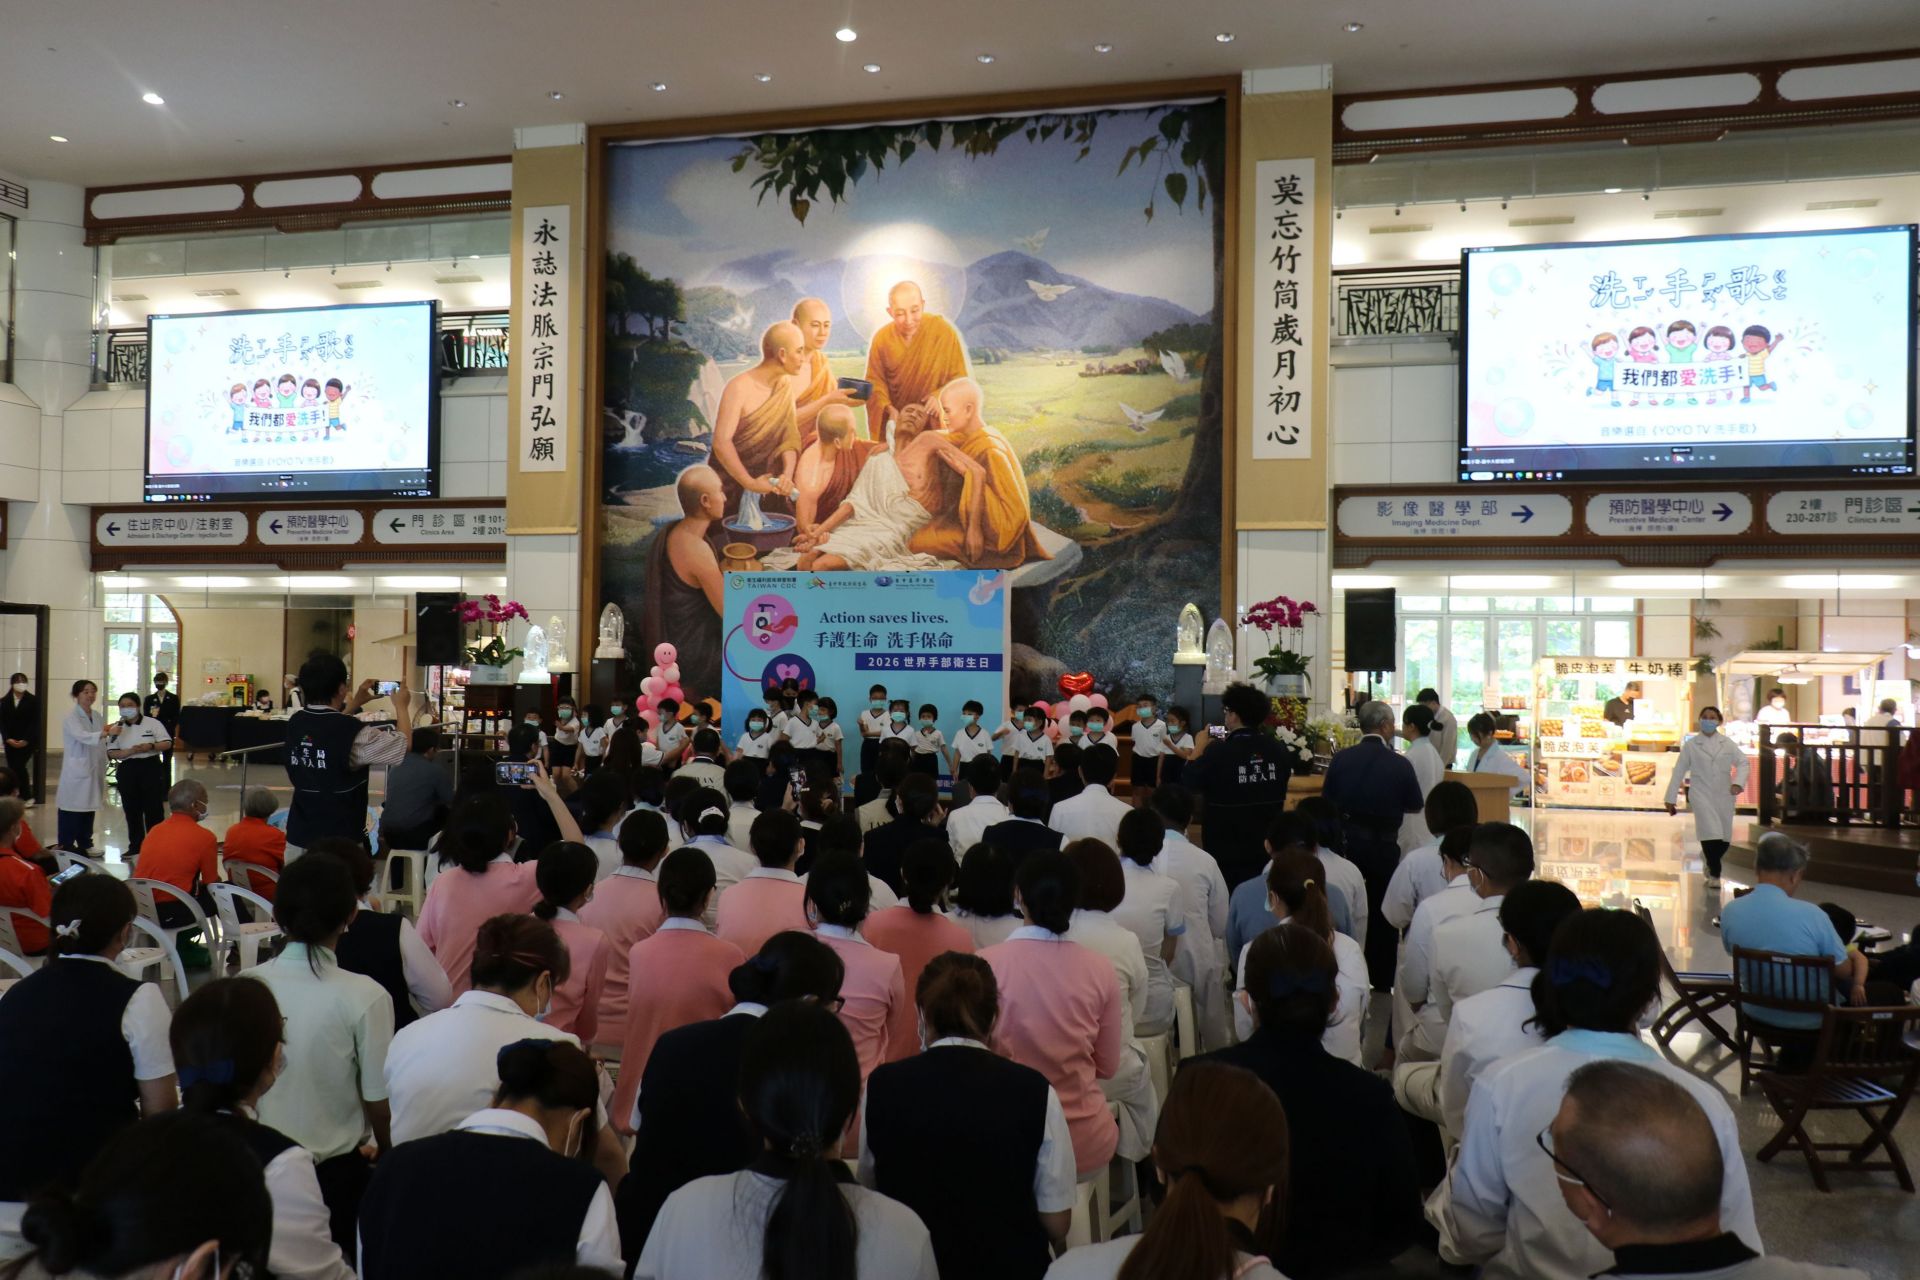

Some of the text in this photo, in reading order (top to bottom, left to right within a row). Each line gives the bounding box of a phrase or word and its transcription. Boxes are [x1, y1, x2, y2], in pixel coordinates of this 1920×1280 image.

[1266, 174, 1304, 446] 莫忘竹筒歲月初心
[528, 218, 559, 462] 永誌法脈宗門弘願
[1376, 500, 1499, 517] 影像醫學部
[1609, 498, 1704, 515] 預防醫學中心
[1800, 499, 1822, 510] 2樓
[1844, 497, 1903, 514] 門診區
[127, 518, 233, 531] 住出院中心/注射室
[286, 514, 349, 528] 預防醫學中心
[411, 513, 466, 528] 門診區
[1391, 519, 1483, 528] Imaging Medicine Dept.
[1608, 516, 1705, 524] Preventive Medicine Center
[1847, 516, 1901, 524] Clinics Area
[819, 611, 949, 624] Action saves lives.
[814, 631, 954, 649] 手護生命 洗手保命
[868, 656, 989, 668] 2026 世界手部衛生日
[1628, 662, 1684, 677] 牛奶棒
